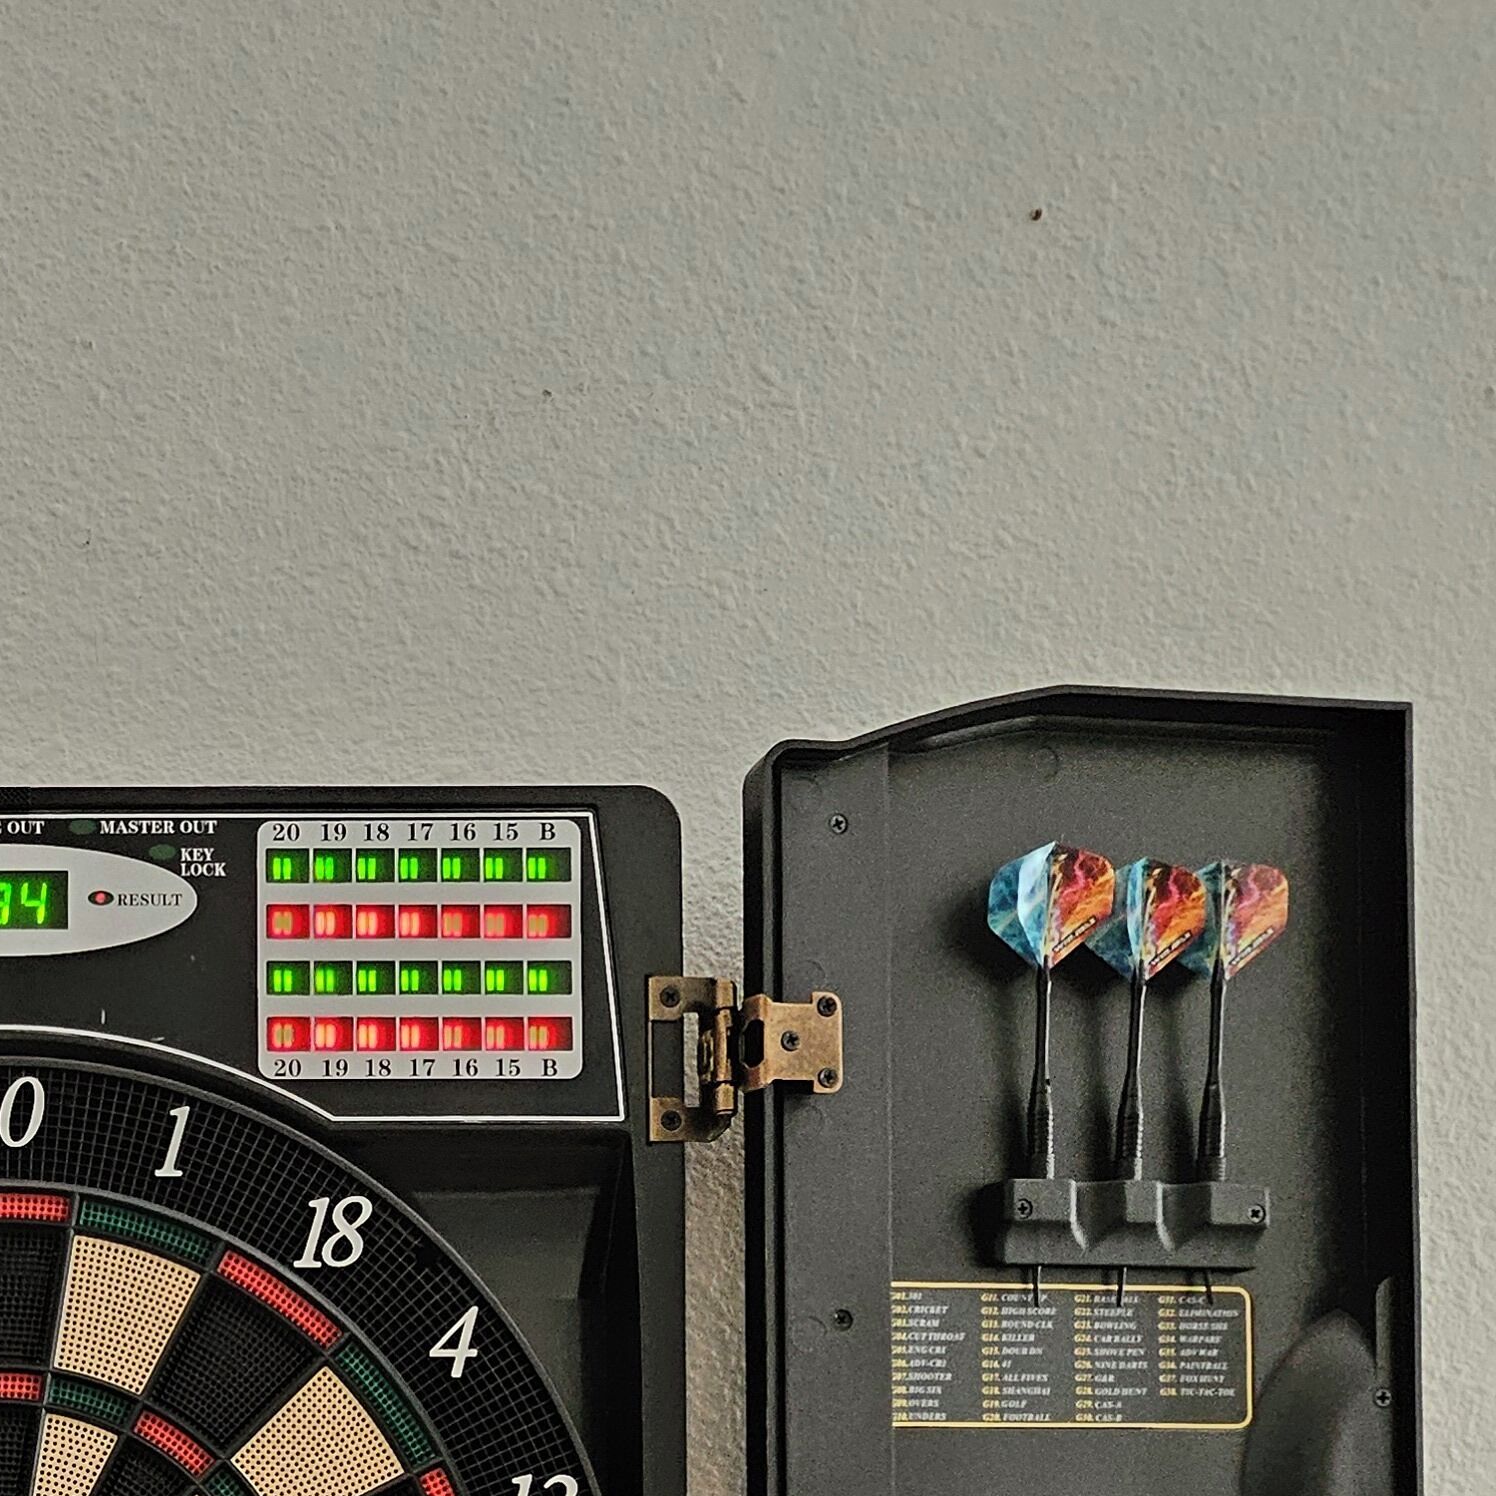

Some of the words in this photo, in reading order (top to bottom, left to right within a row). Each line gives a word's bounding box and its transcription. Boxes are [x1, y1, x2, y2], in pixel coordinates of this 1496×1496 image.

[8, 821, 44, 834] OUT
[100, 821, 175, 834] MASTER
[182, 820, 217, 833] OUT
[273, 824, 299, 841] 20
[322, 823, 346, 841] 19
[364, 823, 389, 841] 18
[408, 823, 433, 841] 17
[451, 823, 475, 840] 16
[494, 823, 518, 840] 15
[540, 823, 555, 840] B
[181, 848, 214, 861] KEY
[181, 863, 225, 877] LOCK
[118, 894, 181, 906] RESULT
[275, 1059, 301, 1076] 20
[323, 1059, 348, 1076] 19
[366, 1059, 391, 1076] 18
[411, 1059, 435, 1076] 17
[454, 1059, 478, 1076] 16
[496, 1059, 520, 1076] 15
[543, 1059, 557, 1076] B
[155, 1106, 190, 1176] 1
[293, 1196, 372, 1267] 18
[429, 1306, 478, 1377] 4
